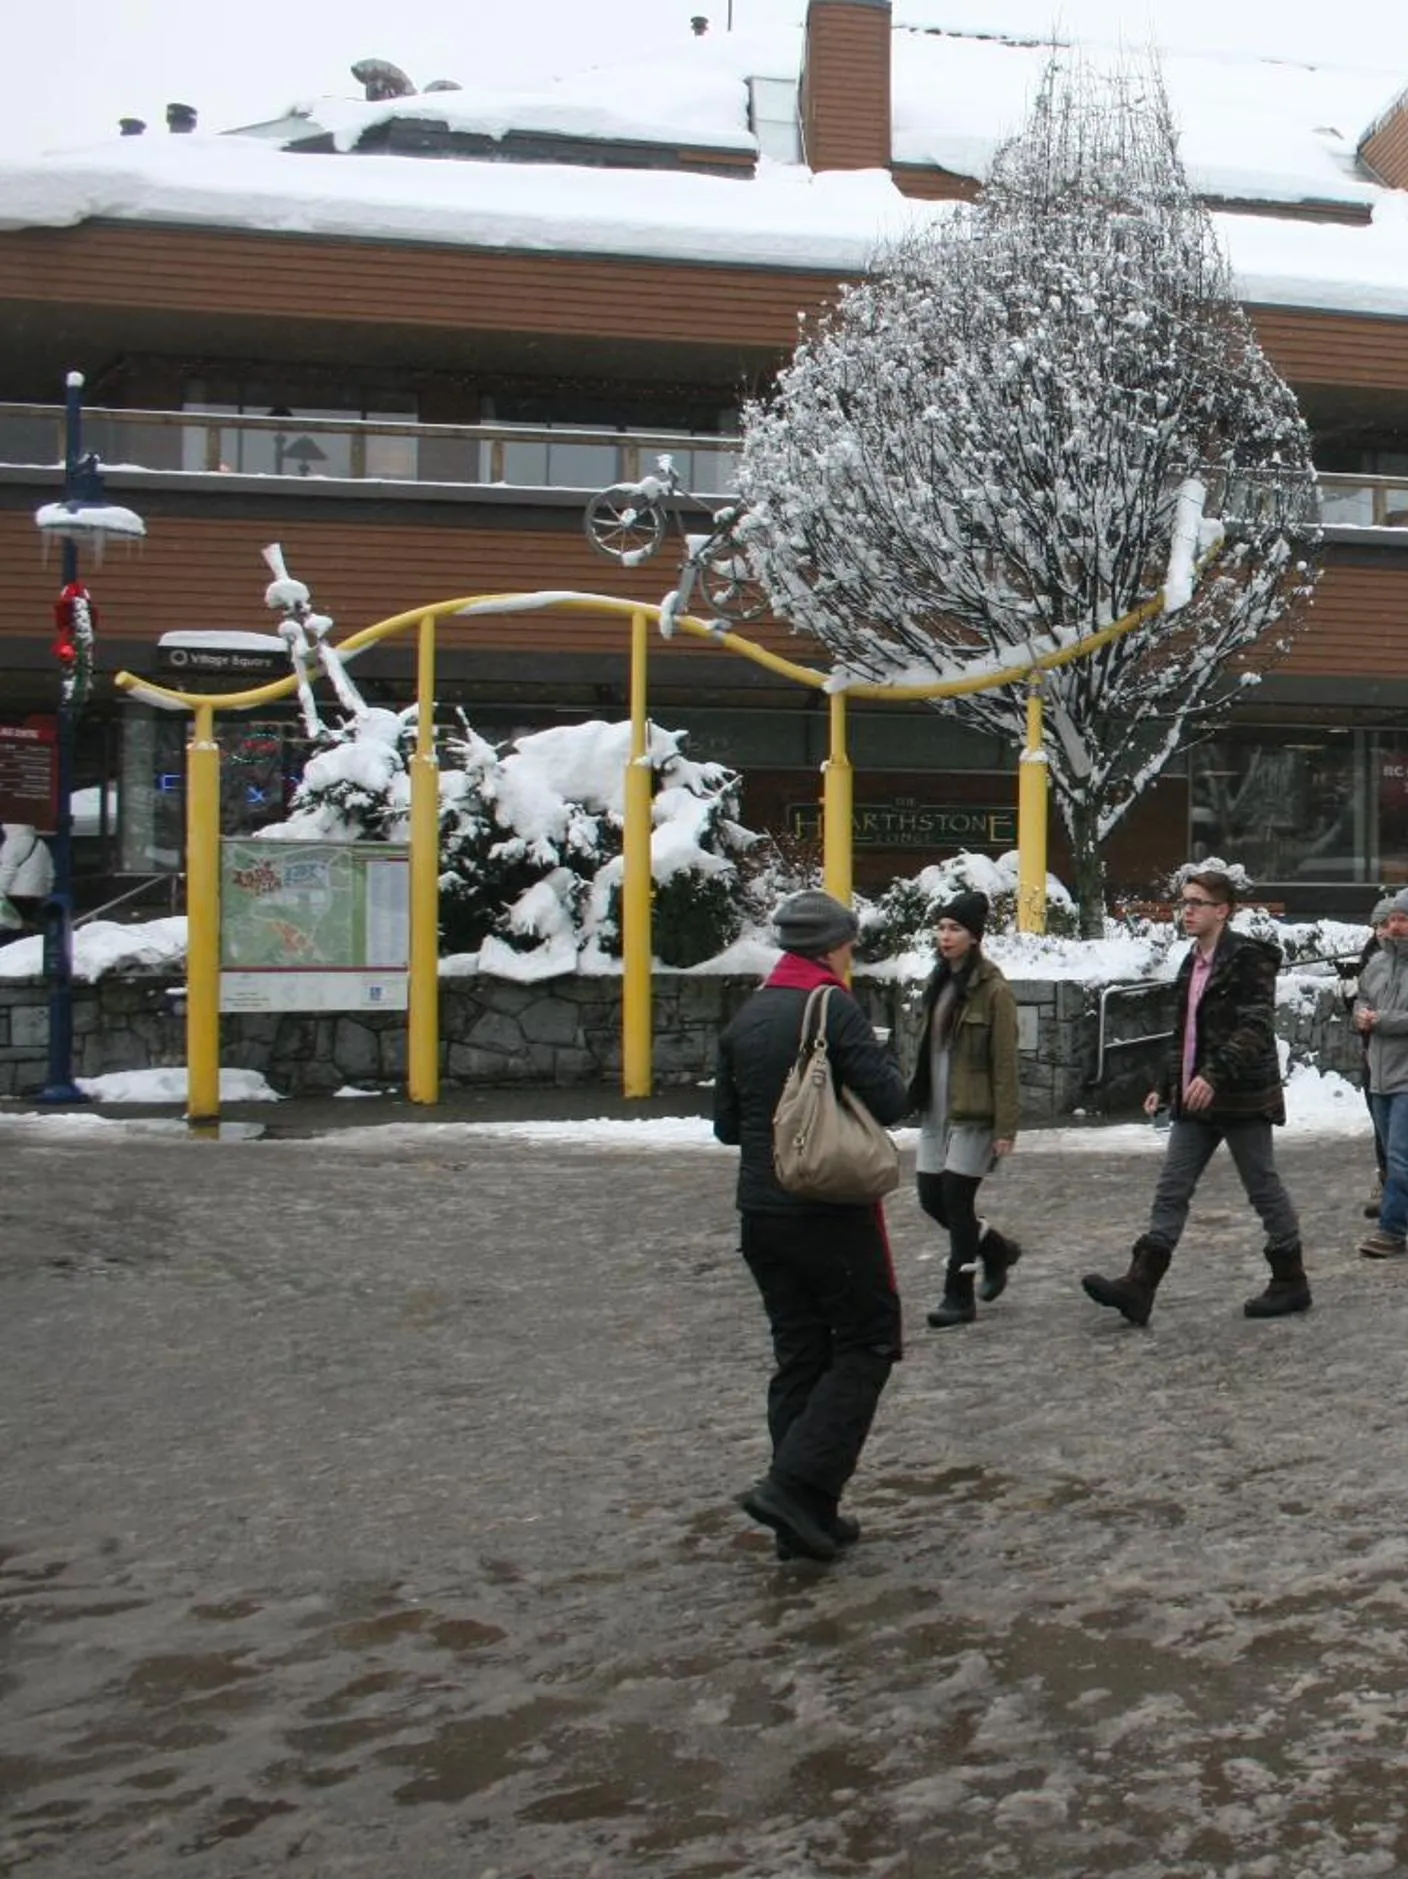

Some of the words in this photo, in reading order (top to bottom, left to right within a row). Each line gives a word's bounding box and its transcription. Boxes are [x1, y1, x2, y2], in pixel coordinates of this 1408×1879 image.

[190, 653, 229, 668] Village
[231, 655, 273, 669] Square
[1383, 765, 1404, 777] BC
[794, 811, 1014, 842] HRTHSTONE
